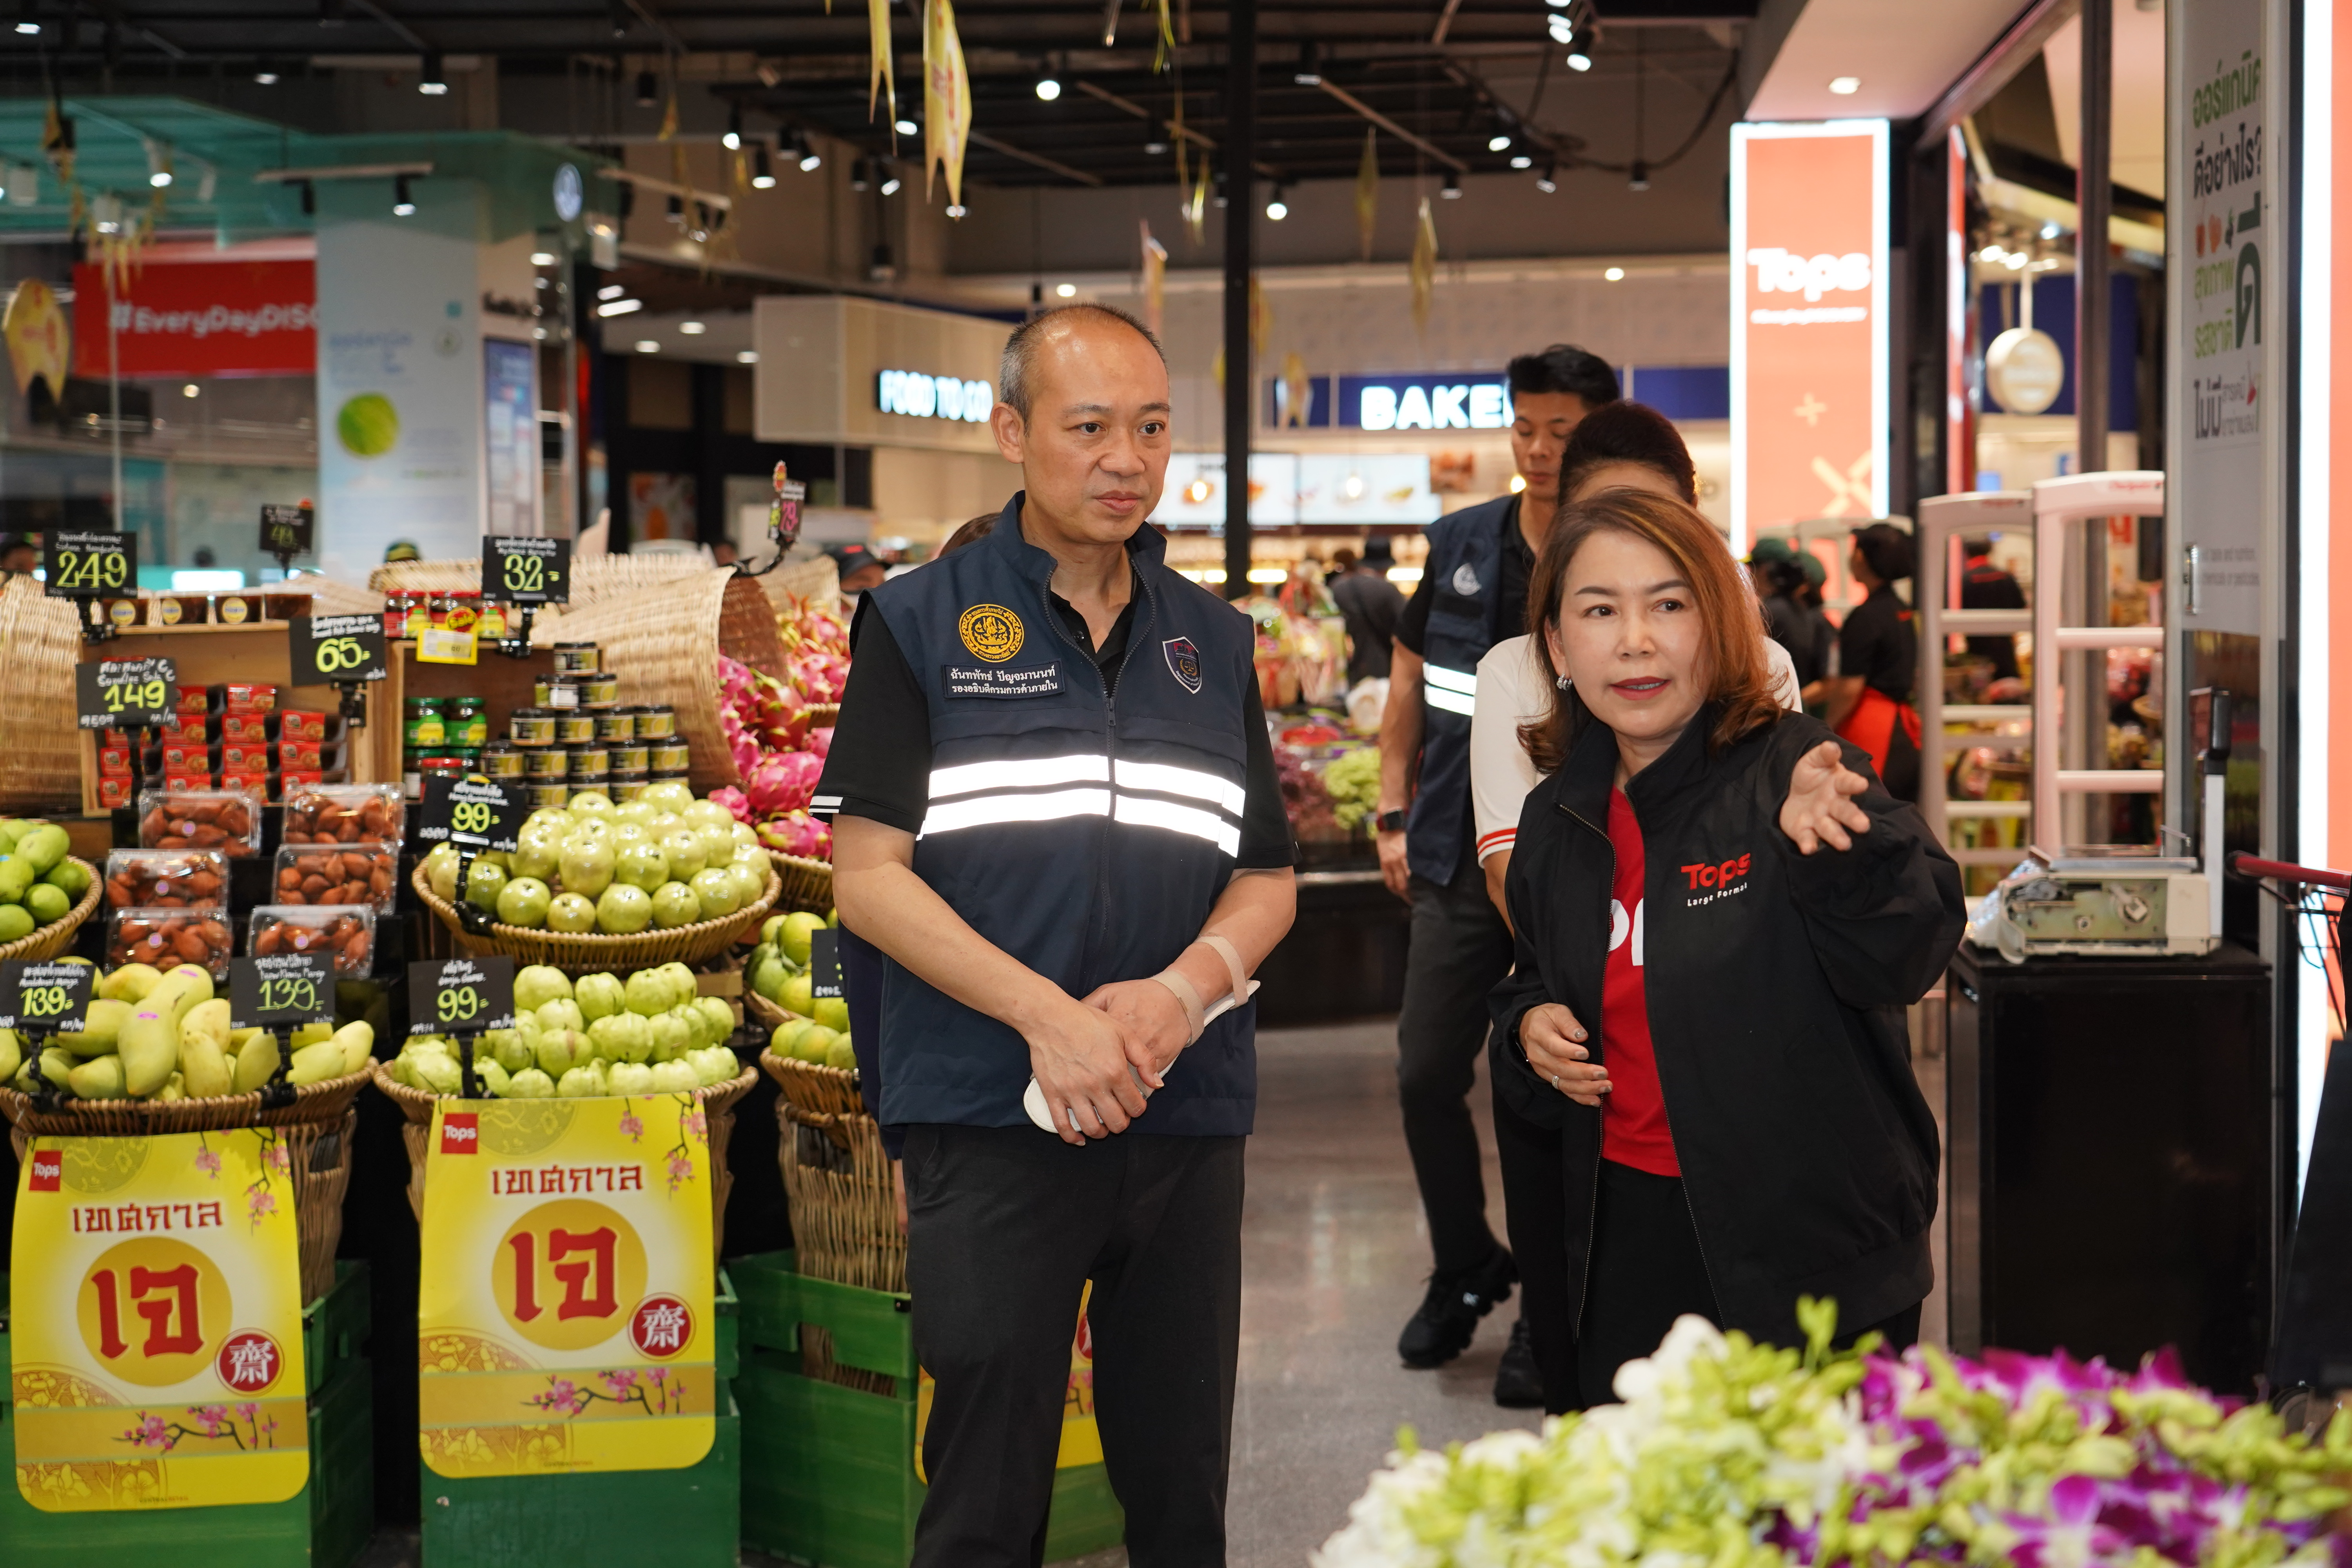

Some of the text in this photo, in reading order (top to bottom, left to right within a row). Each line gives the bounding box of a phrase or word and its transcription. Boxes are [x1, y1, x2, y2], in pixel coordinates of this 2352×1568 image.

[1746, 248, 1872, 302] Tops
[880, 370, 936, 417] FOOD
[935, 376, 964, 421] TO
[57, 551, 127, 588] 249
[951, 664, 1055, 684] ฉันทพัทธ์ ปัญจมานนท์
[952, 679, 1058, 694] รองอธิบดีกรมการค้าภายใน
[103, 680, 166, 712] 149
[1681, 853, 1751, 890] Tops
[1687, 895, 1713, 907] Large
[445, 1125, 476, 1141] Tops
[34, 1161, 60, 1180] Tops
[492, 1165, 643, 1195] เทศกาล
[73, 1201, 223, 1233] เทศกาล
[509, 1226, 619, 1323] เจ
[91, 1263, 205, 1359] เจ
